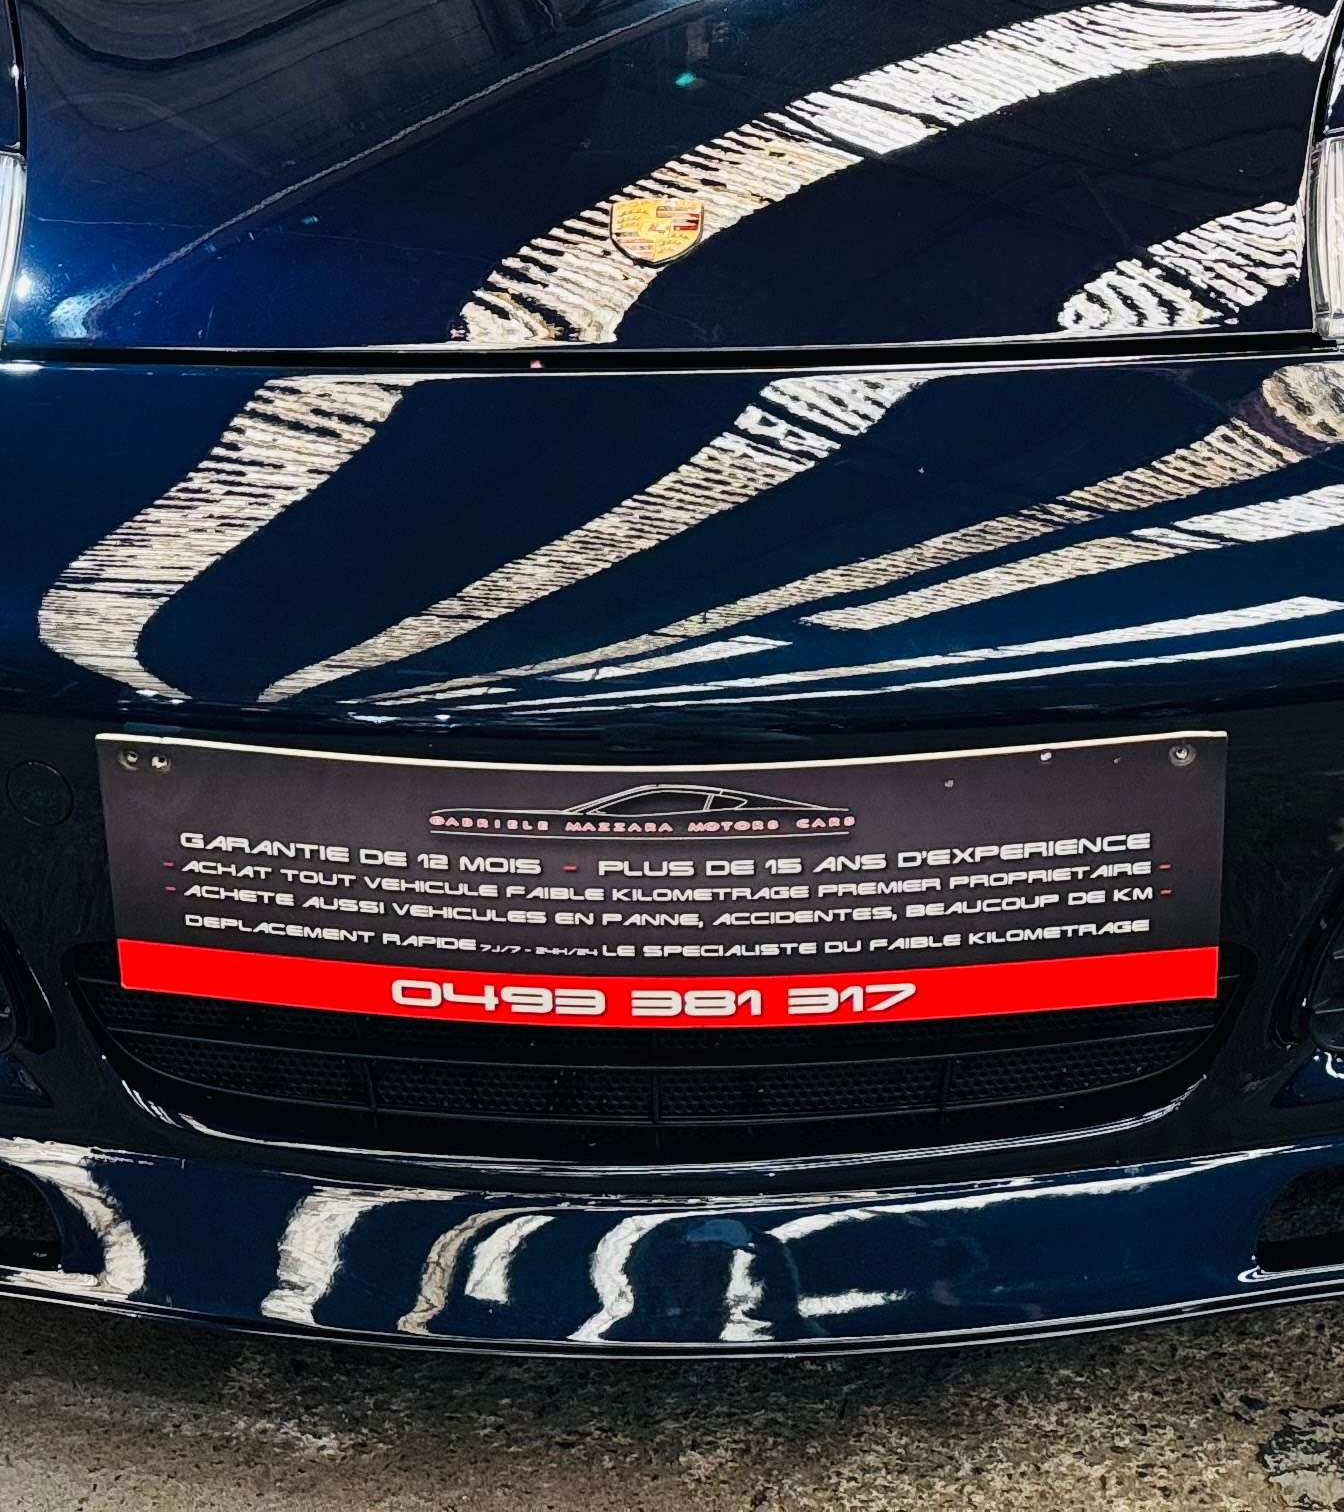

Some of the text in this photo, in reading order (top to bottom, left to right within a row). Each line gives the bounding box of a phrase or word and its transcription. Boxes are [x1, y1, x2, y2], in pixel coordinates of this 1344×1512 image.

[428, 815, 856, 833] GABRIELE MAZZARA MOTORS CARS
[179, 832, 351, 863] GARANTIE
[359, 848, 408, 867] DE
[416, 853, 449, 870] 12
[459, 855, 542, 875] MOIS
[598, 860, 696, 877] PLUS
[706, 859, 755, 876] DE
[764, 857, 803, 875] 15
[813, 853, 887, 873] ANS
[897, 832, 1152, 868] D'EXPERIENCE
[181, 860, 273, 880] ACHAT
[279, 868, 357, 887] TOUT
[363, 875, 499, 898] VEHICULE
[506, 885, 605, 901] FAIBLE
[611, 885, 810, 902] KILOMETRAGE
[817, 877, 942, 898] PREMIER
[949, 861, 1152, 890] PROPRIETAIRE
[184, 884, 295, 906] ACHETE
[302, 896, 385, 914] AUSSI
[392, 902, 548, 925] VEHICULES
[555, 912, 595, 926] EN
[601, 912, 704, 929] PANNE,
[712, 906, 898, 926] ACCIDENTES,
[905, 893, 1060, 918] BEAUCOUP
[1068, 890, 1106, 906] DE
[1113, 886, 1154, 902] KM
[184, 914, 376, 944] DEPLACEMENT
[382, 933, 477, 952] RAPIDE
[479, 943, 522, 954] 7J/7
[602, 944, 636, 957] LE
[643, 942, 817, 957] SPECIALISTE
[824, 940, 862, 954] DU
[869, 934, 961, 951] FAIBLE
[968, 919, 1151, 945] KILOMETRAGE
[391, 979, 917, 1017] 0493 381 317
